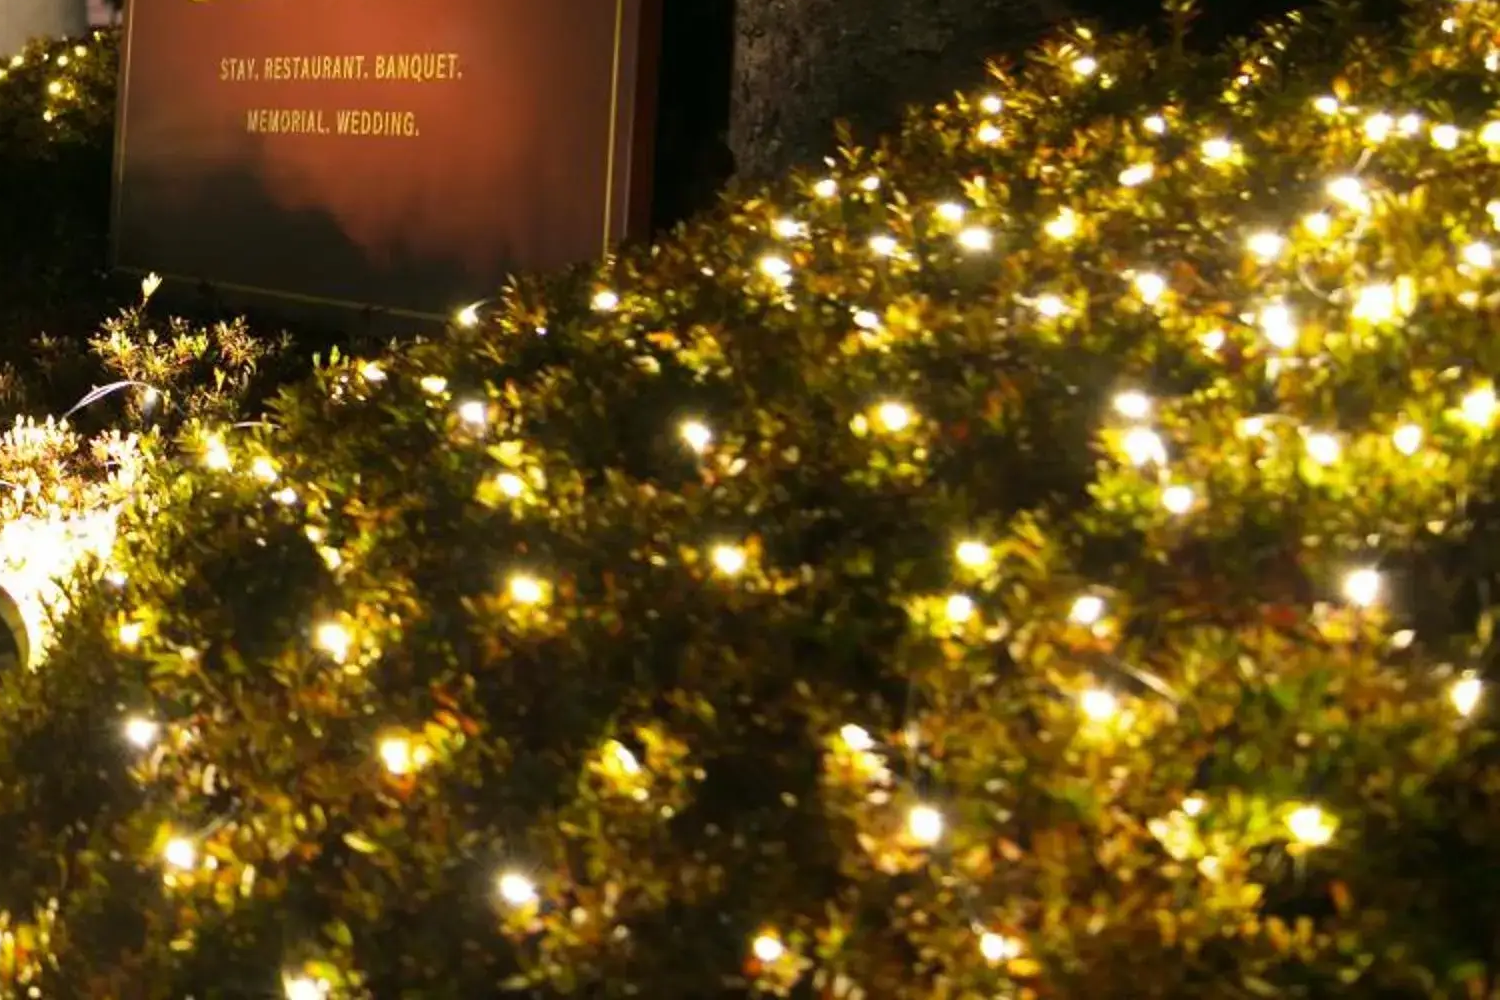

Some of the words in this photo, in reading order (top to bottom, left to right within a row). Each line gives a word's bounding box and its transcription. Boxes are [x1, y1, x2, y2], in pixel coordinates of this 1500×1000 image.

[220, 57, 260, 82] STAY.
[265, 56, 369, 80] RESTAURANT.
[375, 53, 463, 83] BANQUET.
[247, 109, 330, 134] MEMORIAL.
[336, 110, 420, 137] WEDDING.
